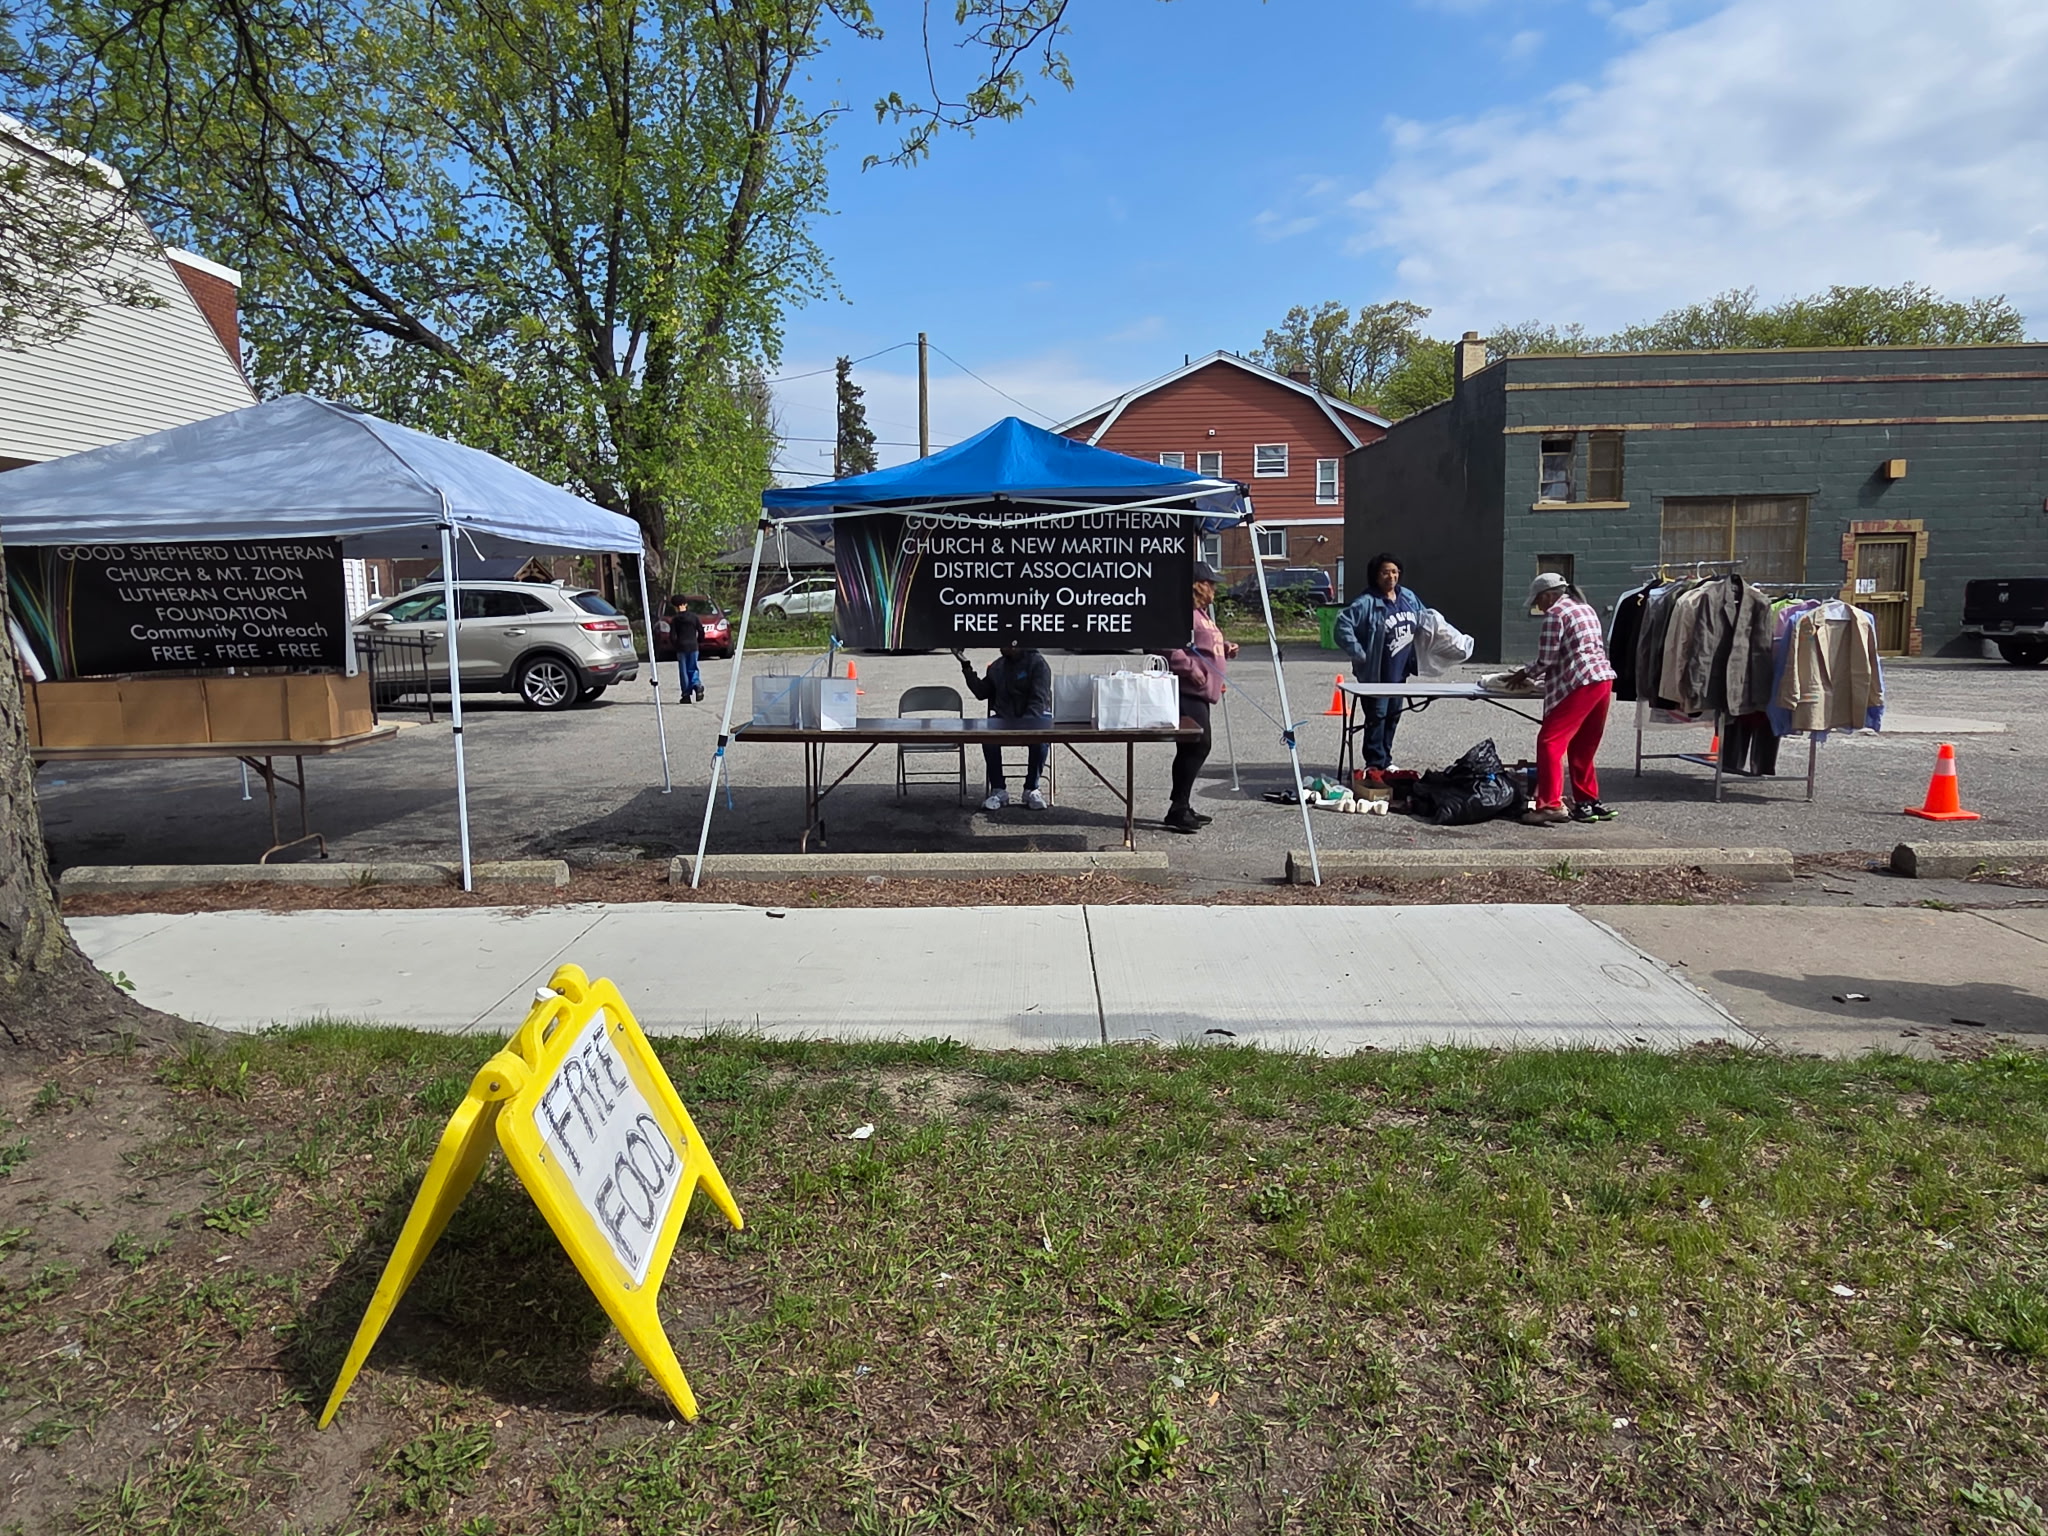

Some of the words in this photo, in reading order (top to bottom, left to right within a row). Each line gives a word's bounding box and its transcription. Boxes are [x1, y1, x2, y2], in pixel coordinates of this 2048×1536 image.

[906, 513, 970, 530] GOOD
[1082, 513, 1181, 529] LUTHERAN
[57, 546, 125, 562] GOOD
[130, 545, 228, 561] SHEPHERD
[234, 545, 334, 561] LUTHERAN
[902, 538, 984, 554] CHURCH
[991, 538, 1004, 554] &
[1011, 538, 1057, 553] NEW
[1061, 538, 1133, 554] MARTIN
[1141, 537, 1185, 554] PARK
[106, 568, 191, 582] CHURCH
[197, 568, 212, 581] &
[217, 568, 247, 581] MT.
[255, 567, 303, 581] ZION
[935, 562, 1015, 579] DISTRICT
[1020, 562, 1152, 579] ASSOCIATION
[119, 588, 218, 602] LUTHERAN
[223, 586, 307, 601] CHURCH
[939, 589, 1050, 610] Community
[1056, 588, 1146, 606] Outreach
[156, 607, 287, 621] FOUNDATION
[939, 587, 1050, 610] FREE
[1020, 615, 1064, 632] FREE
[1087, 615, 1132, 632] FREE
[131, 625, 237, 641] Community
[243, 622, 328, 638] Outreach
[151, 646, 197, 661] FREE
[216, 644, 260, 659] FREE
[279, 643, 323, 657] FREE
[542, 1023, 629, 1176] FREE
[595, 1113, 676, 1271] FOOD
